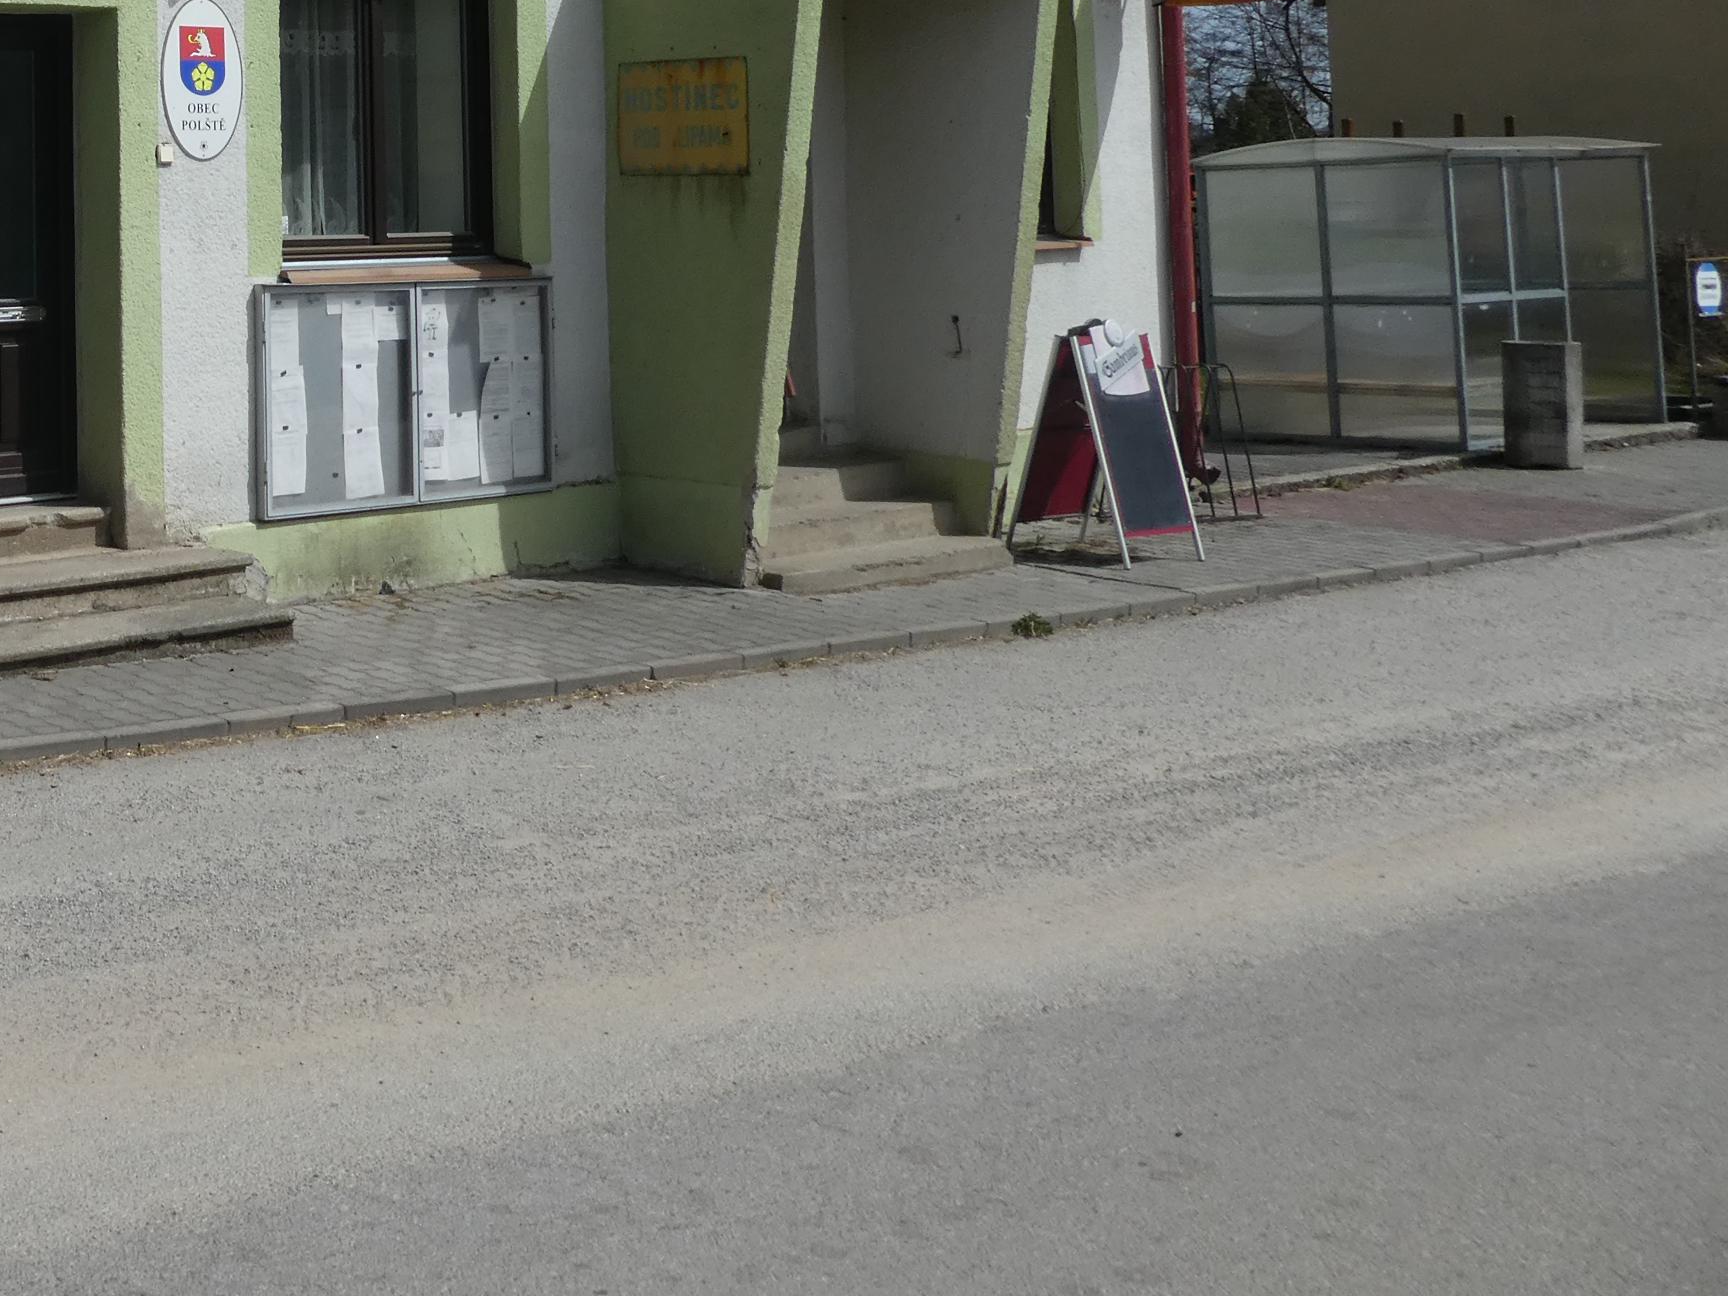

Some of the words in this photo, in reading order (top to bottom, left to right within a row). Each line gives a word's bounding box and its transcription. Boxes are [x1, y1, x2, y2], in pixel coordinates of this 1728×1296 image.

[622, 82, 740, 113] HOSTINEC
[187, 103, 219, 114] OBEC
[182, 117, 226, 131] POLŠTĚ
